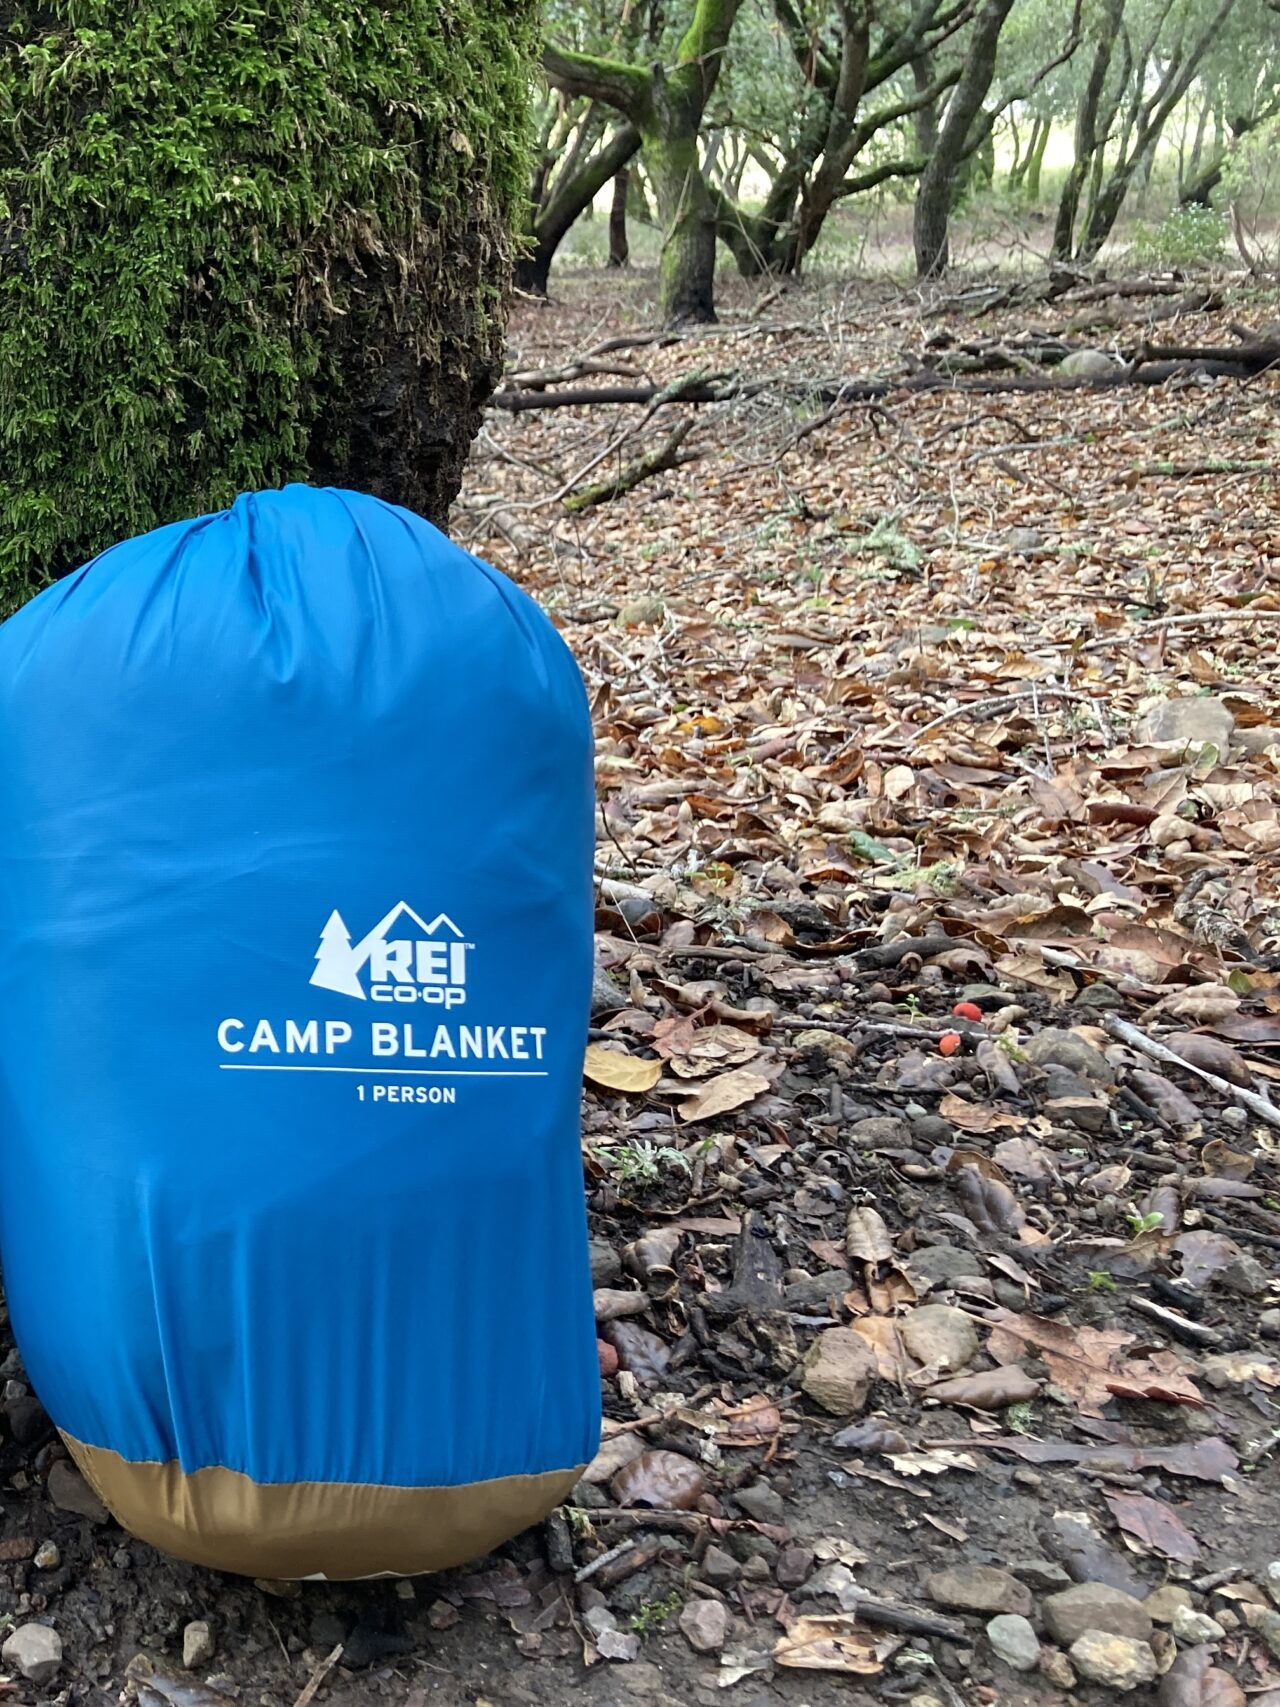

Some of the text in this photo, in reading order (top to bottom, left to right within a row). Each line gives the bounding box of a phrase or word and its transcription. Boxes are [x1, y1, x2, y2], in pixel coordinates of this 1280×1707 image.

[370, 939, 466, 985] REI
[218, 1018, 547, 1060] CAMP BLANKET
[356, 1085, 456, 1104] 1 PERSON
